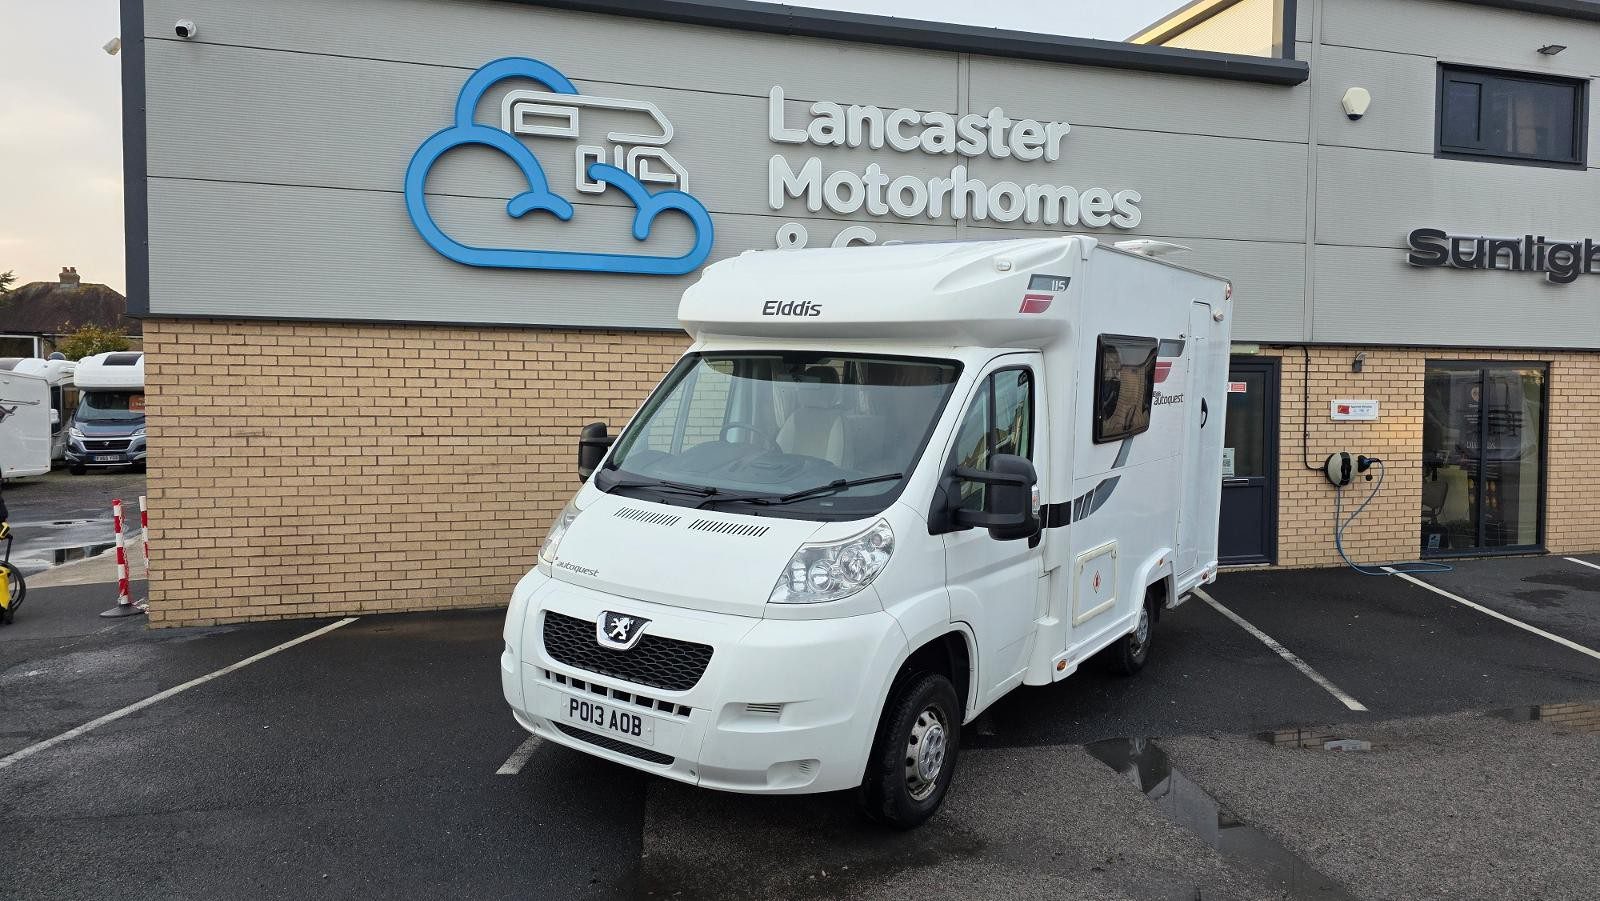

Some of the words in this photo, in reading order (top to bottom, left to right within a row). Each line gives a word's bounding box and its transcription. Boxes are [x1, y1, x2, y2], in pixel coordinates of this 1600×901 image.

[768, 85, 1071, 163] Lancaster
[768, 154, 1142, 229] Motorhomes
[1051, 279, 1066, 292] 115
[762, 300, 822, 317] Elddis
[1153, 393, 1184, 406] autoquest
[556, 561, 600, 578] autoquest
[569, 697, 605, 727] PO13
[609, 709, 642, 737] AOB
